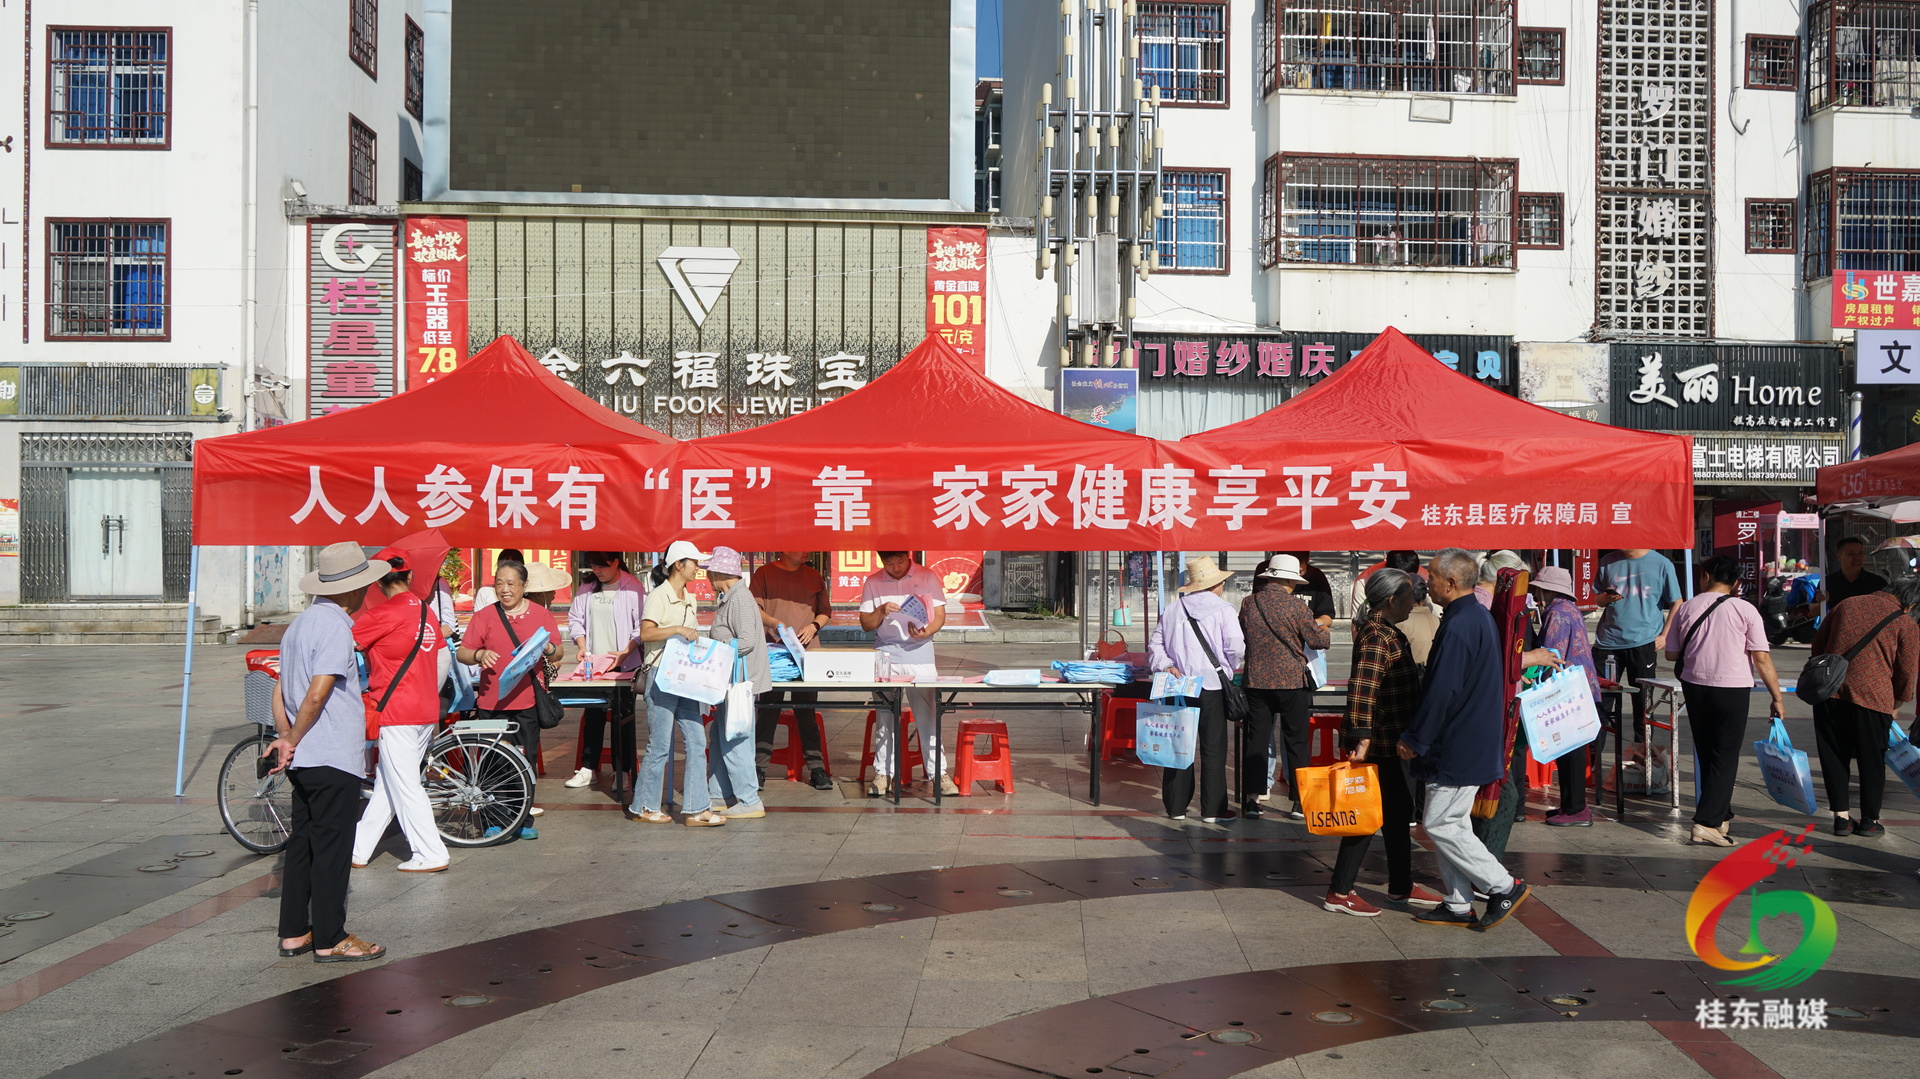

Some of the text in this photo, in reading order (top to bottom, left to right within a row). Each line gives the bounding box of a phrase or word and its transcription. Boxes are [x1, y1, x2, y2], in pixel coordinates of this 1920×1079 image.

[1636, 85, 1675, 299] 罗门婚纱
[406, 229, 463, 248] 喜迎中秋
[929, 238, 982, 258] 喜迎中秋
[410, 247, 467, 263] 欢度国庆
[421, 269, 451, 283] 标价
[933, 280, 980, 292] 黄金直降
[425, 284, 448, 329] 玉器
[932, 294, 982, 325] 101
[1844, 303, 1895, 315] 房屋租售
[1843, 315, 1895, 326] 产权过户
[319, 277, 382, 416] 桂星童
[423, 331, 452, 344] 低至
[940, 329, 973, 344] 元/克
[418, 347, 457, 373] 7.8
[1880, 340, 1911, 374] 文
[539, 347, 867, 390] 金六福珠宝
[1629, 351, 1822, 408] 美丽 Home
[654, 396, 723, 414] FOOK
[1090, 405, 1109, 424] 爱
[1692, 443, 1840, 469] 富士电梯有限公司
[1748, 471, 1797, 479] 13873971003
[932, 463, 1411, 532] 家家健康享平安
[1421, 502, 1632, 526] 桂东县医疗保障局 宣
